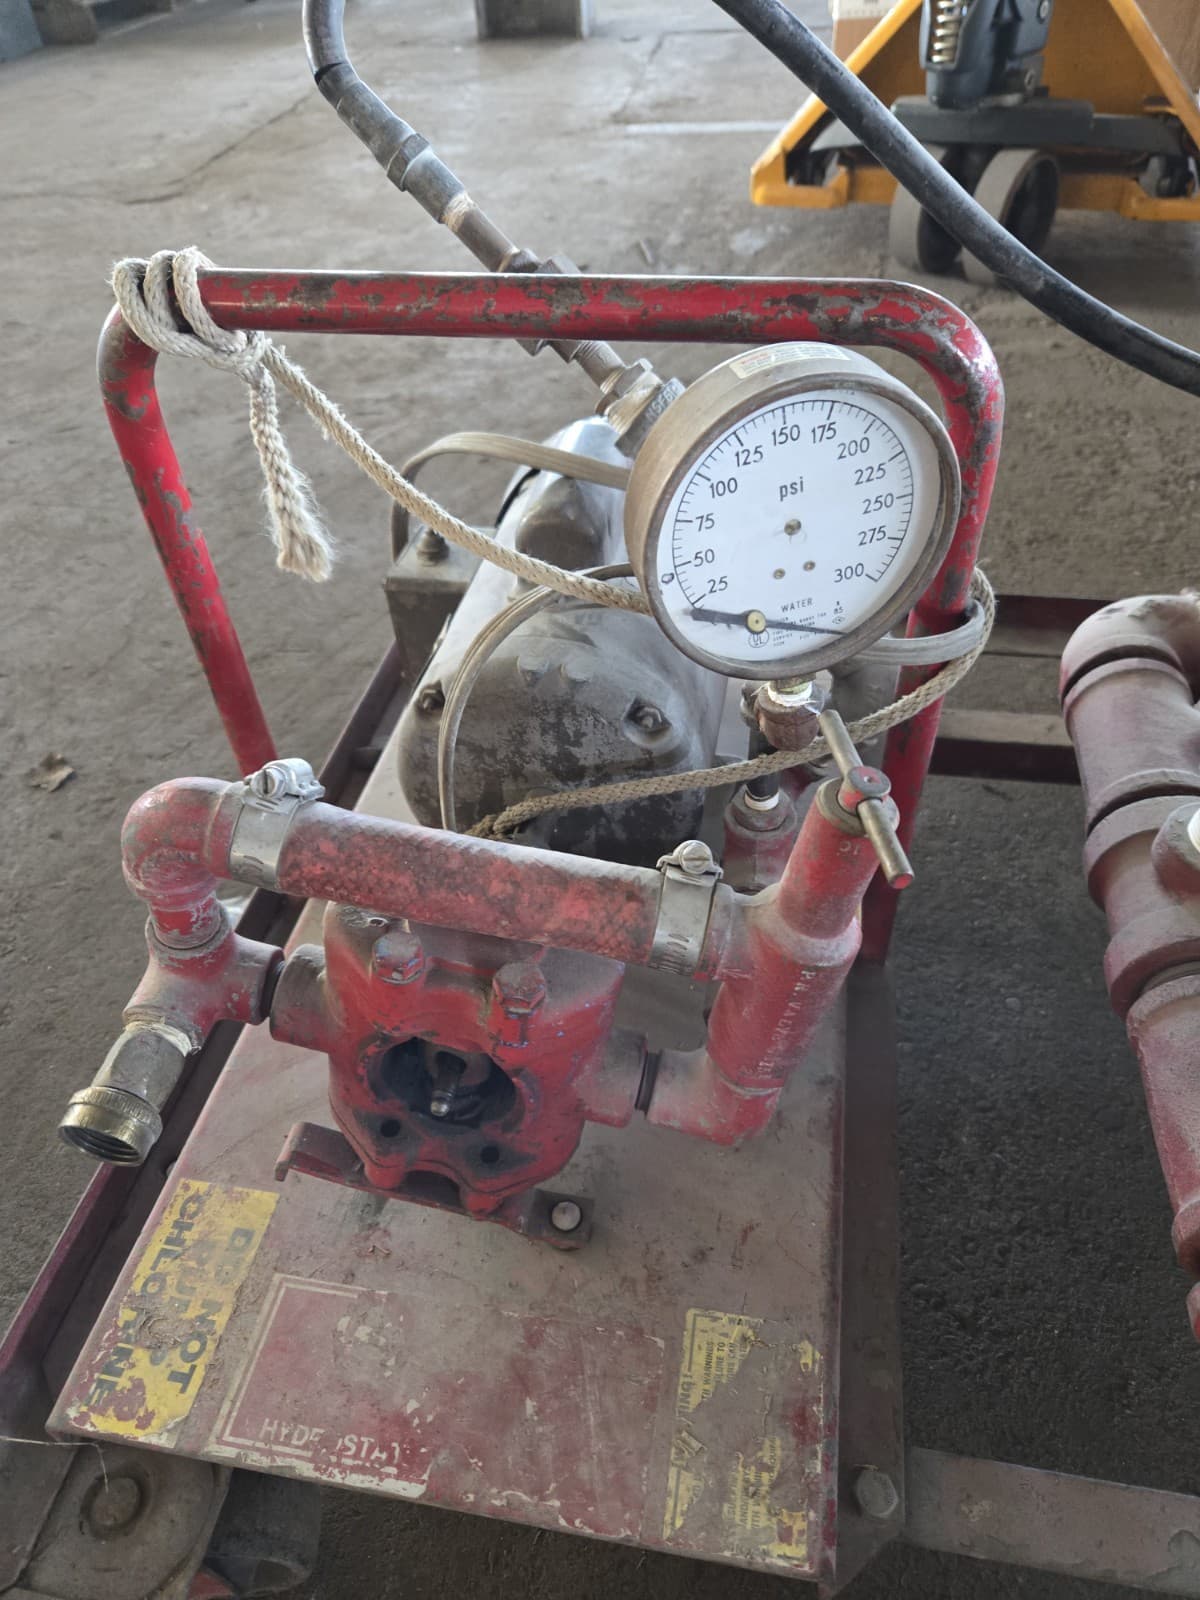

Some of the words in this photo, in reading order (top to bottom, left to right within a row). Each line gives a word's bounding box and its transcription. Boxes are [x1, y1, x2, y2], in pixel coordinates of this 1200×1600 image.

[772, 424, 800, 446] 150
[812, 422, 837, 443] 175
[735, 446, 764, 467] 125
[837, 437, 870, 460] 200
[854, 463, 886, 486] 225
[709, 477, 738, 499] 100
[779, 476, 804, 501] psi
[862, 493, 894, 515] 250
[696, 513, 715, 531] 75
[858, 525, 887, 546] 275
[694, 550, 715, 567] 50
[834, 563, 864, 583] 300
[708, 576, 728, 594] 25
[781, 598, 813, 613] WATER
[167, 1299, 224, 1394] NOT
[717, 1341, 726, 1352] TO
